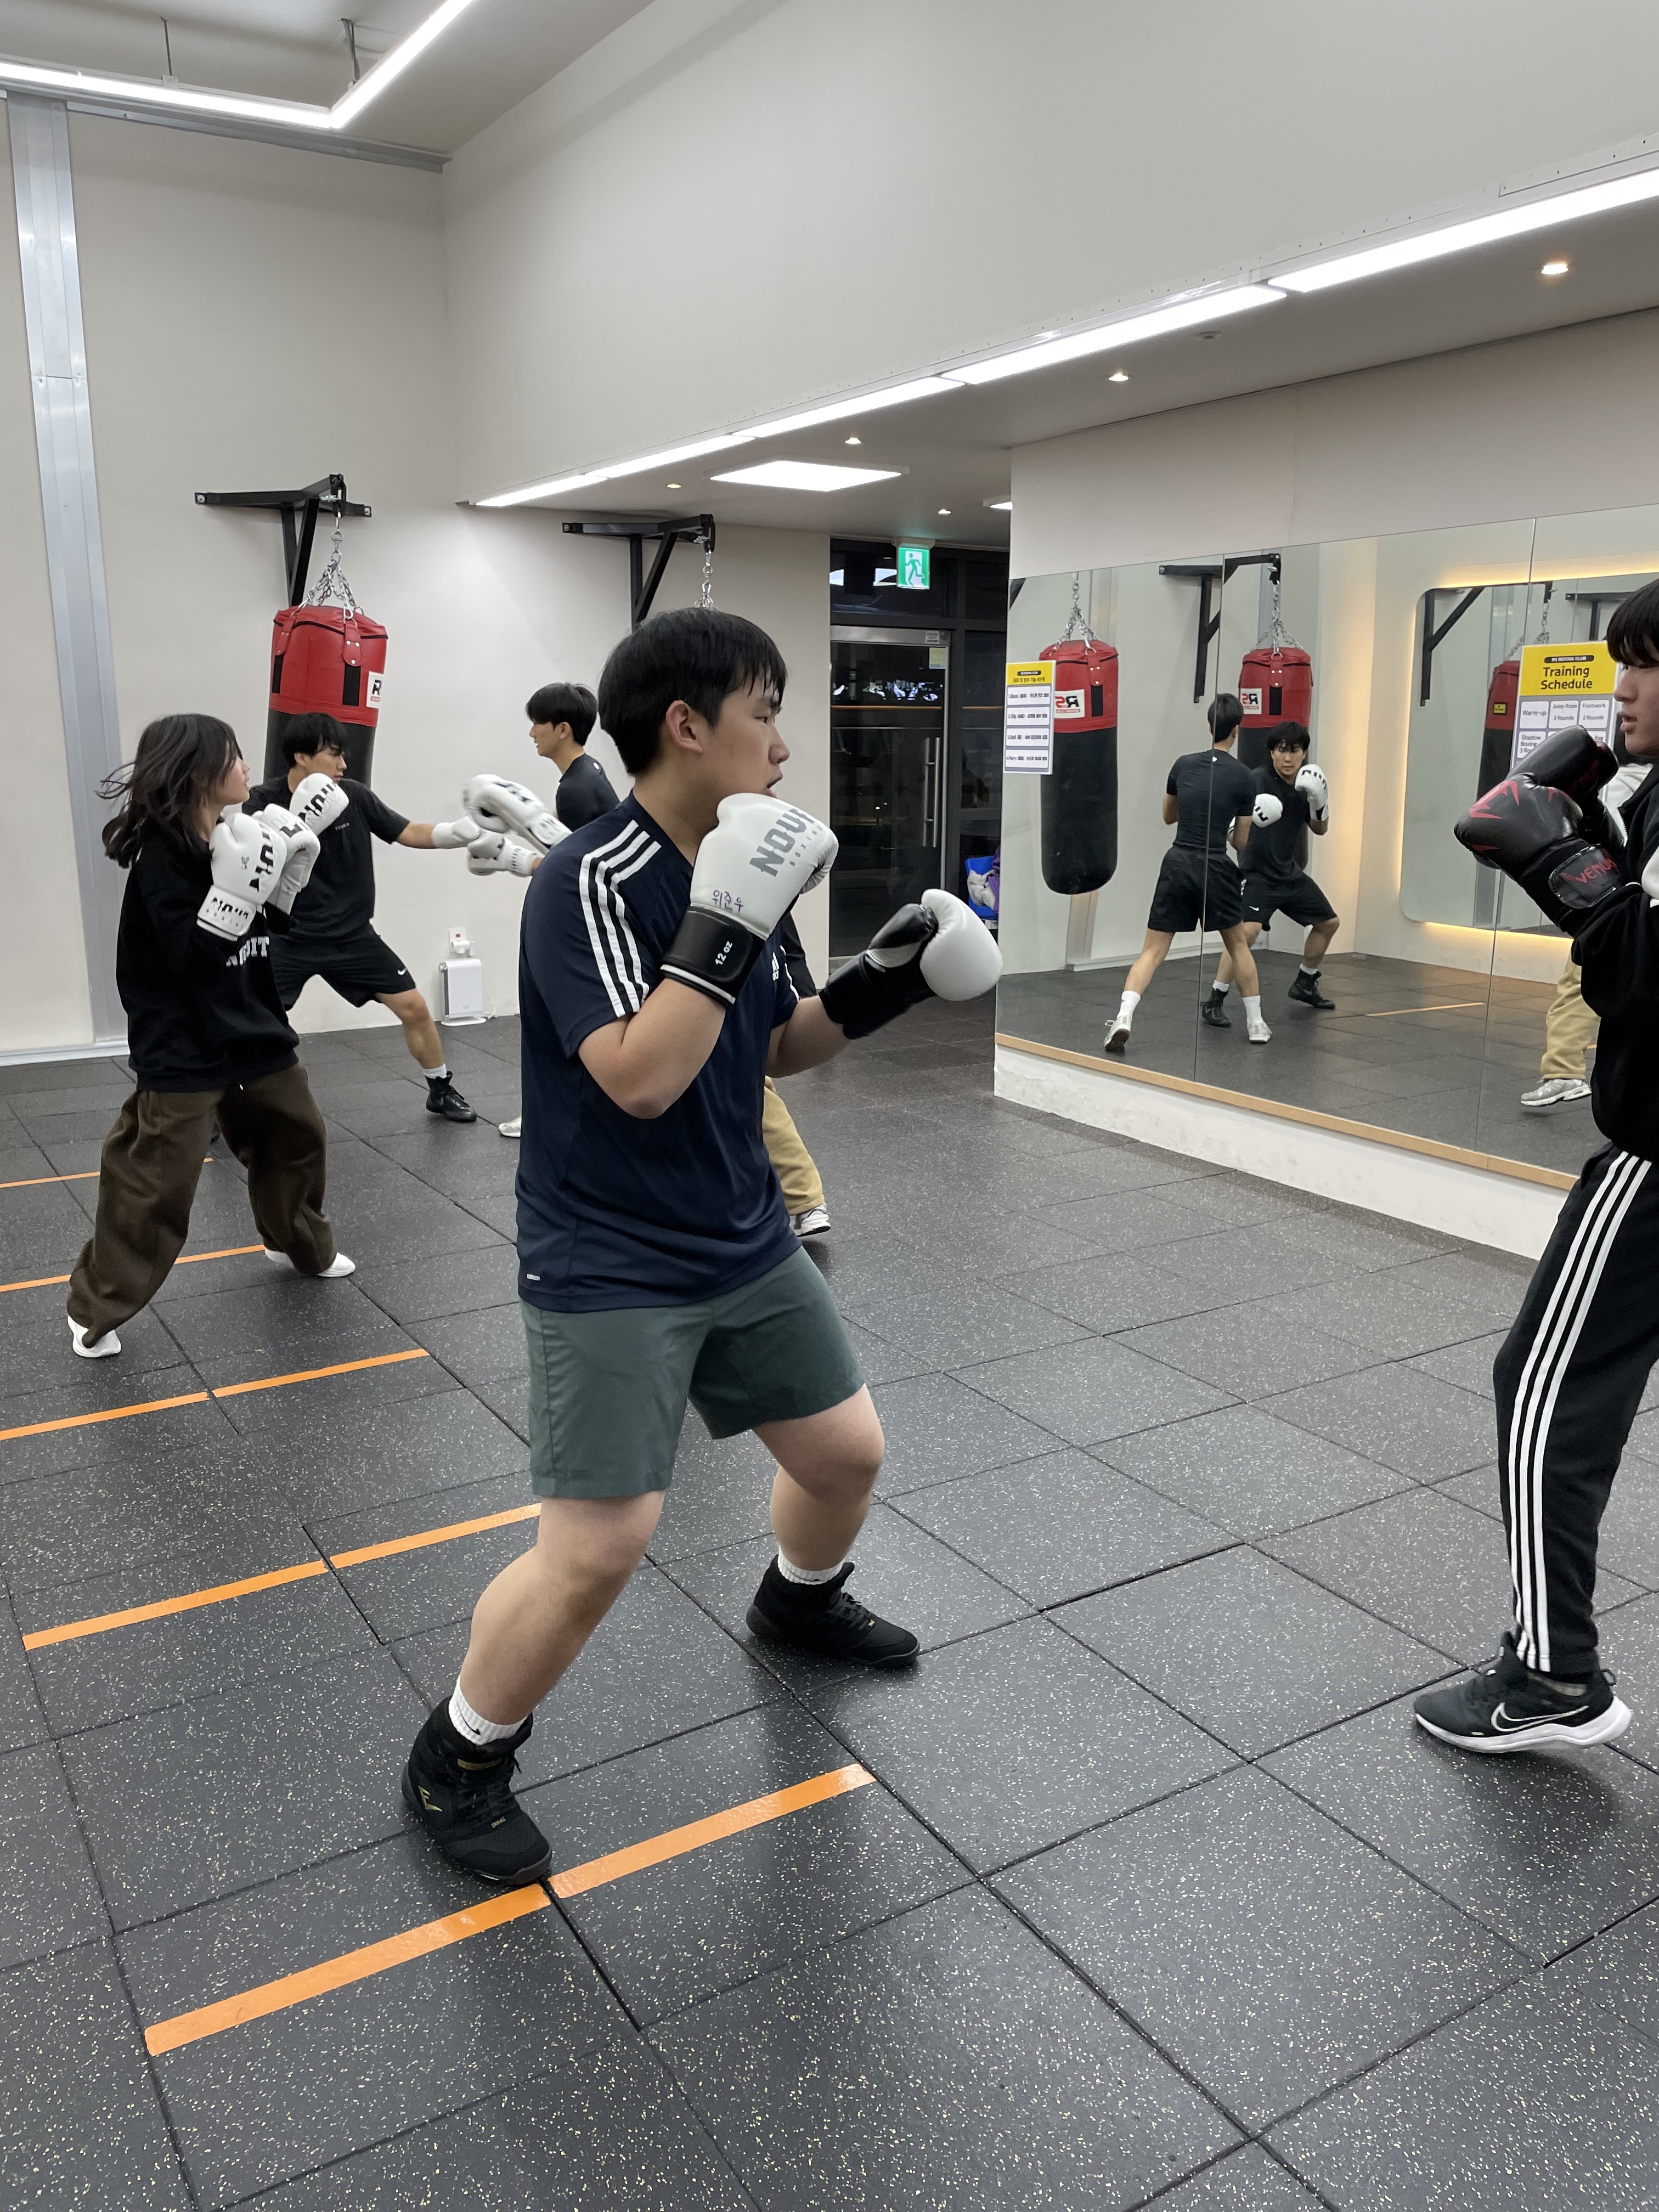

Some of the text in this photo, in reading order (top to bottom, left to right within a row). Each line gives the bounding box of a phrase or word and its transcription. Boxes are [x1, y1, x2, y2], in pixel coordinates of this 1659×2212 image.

[1543, 665, 1590, 678] Training
[1541, 679, 1593, 690] Schedule
[712, 889, 744, 914] 위준우
[715, 951, 727, 966] 12
